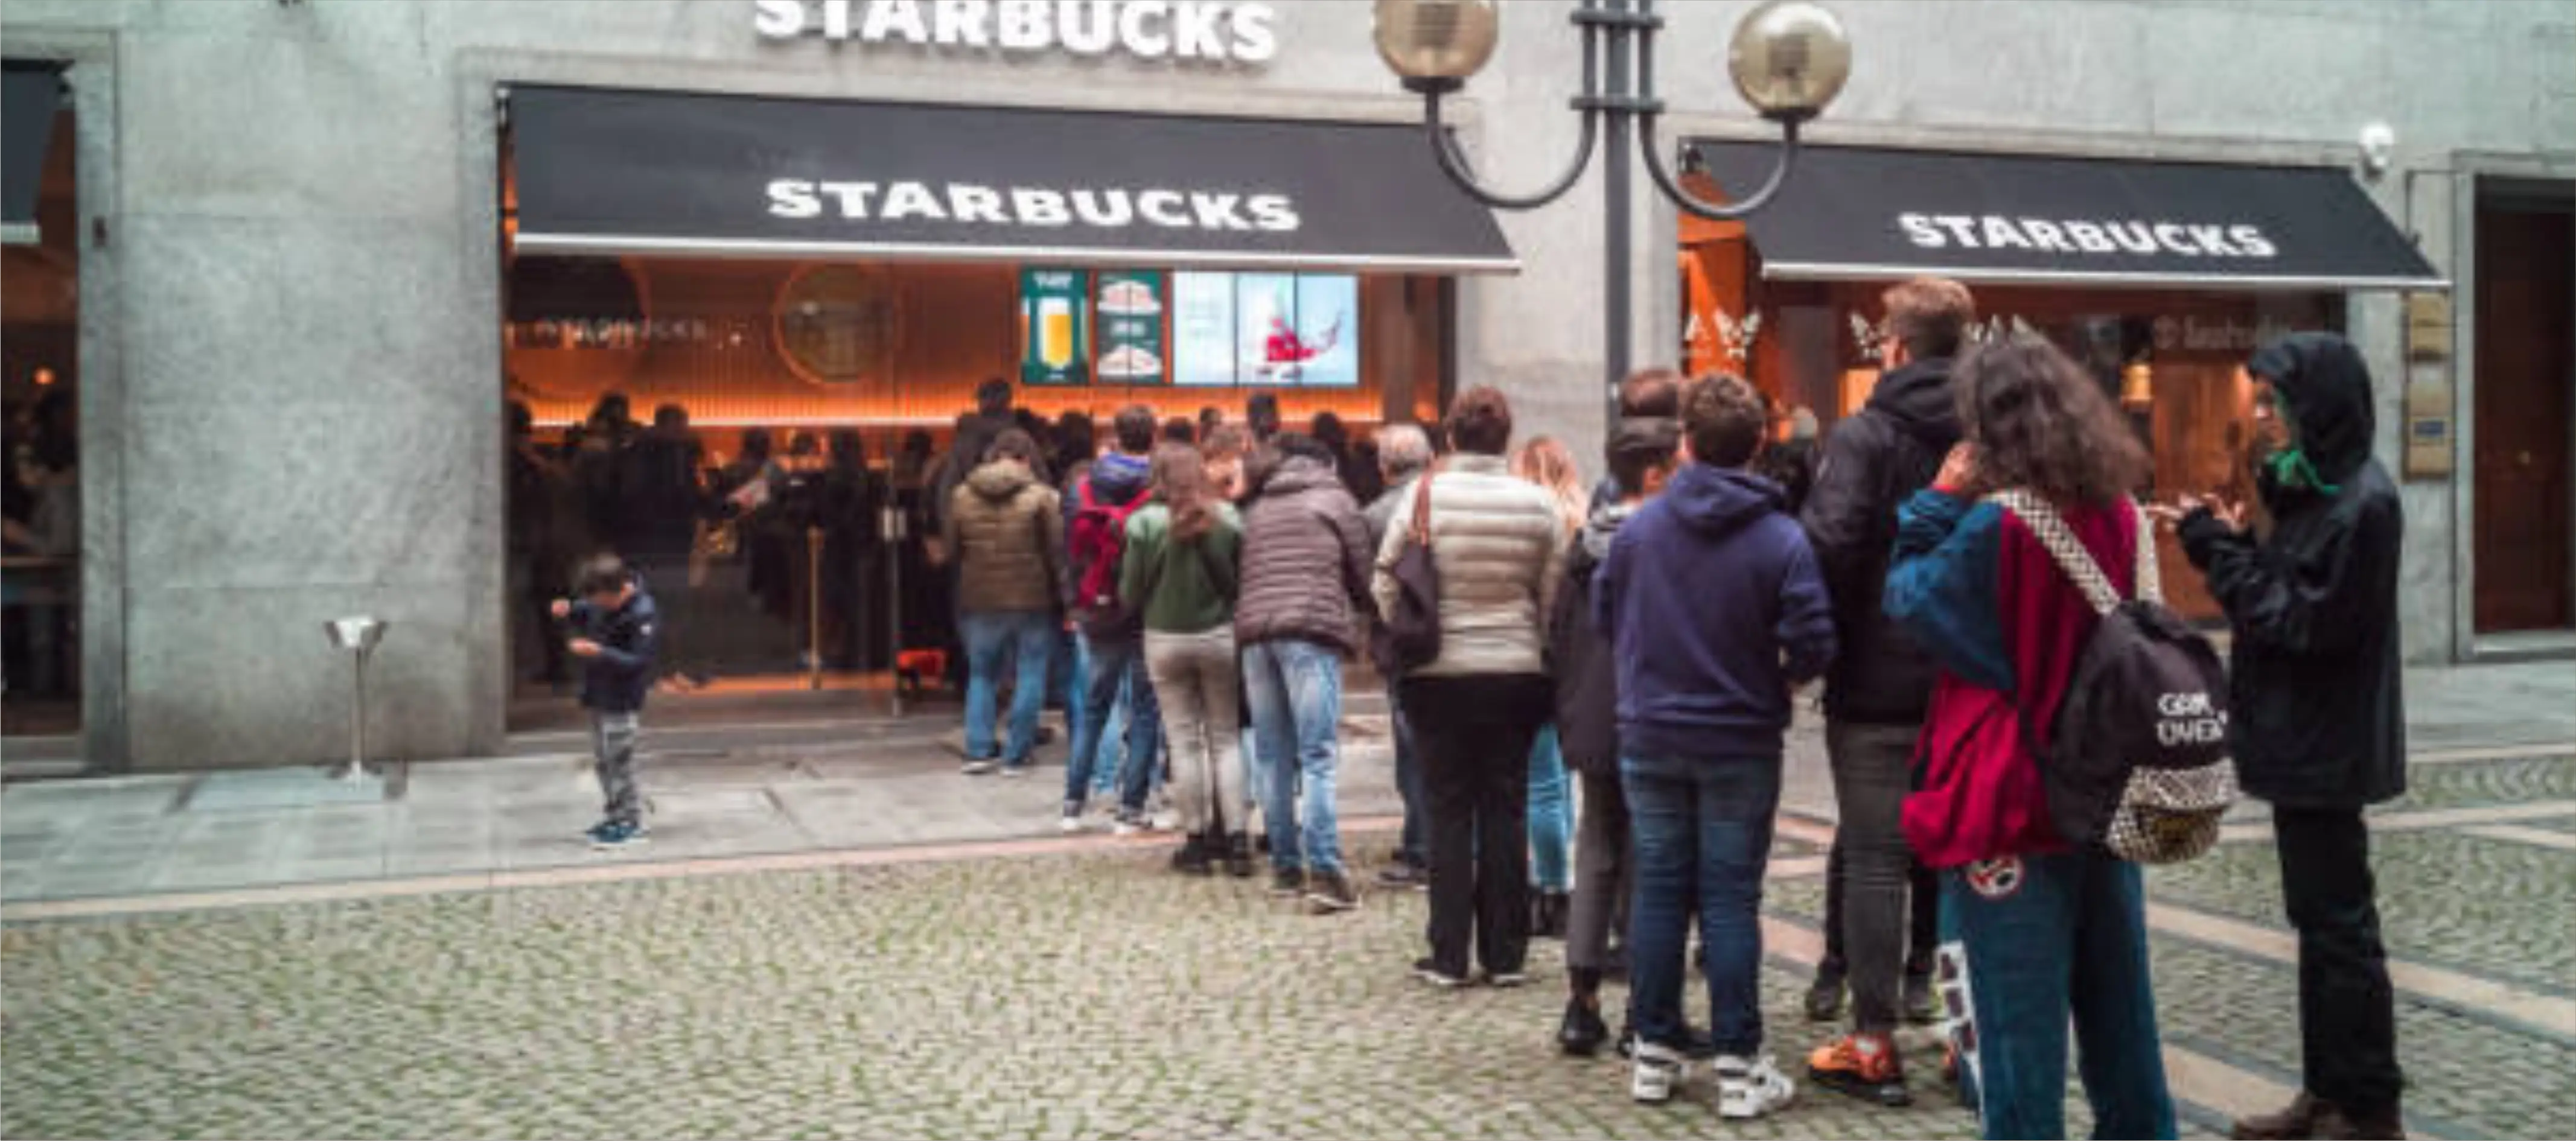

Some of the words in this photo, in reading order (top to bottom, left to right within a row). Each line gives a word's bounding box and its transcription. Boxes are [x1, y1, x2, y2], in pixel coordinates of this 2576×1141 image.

[754, 0, 1275, 60] STARBUCKS
[765, 179, 1300, 230] STARBUCKS
[1898, 212, 2276, 257] STARBUCKS
